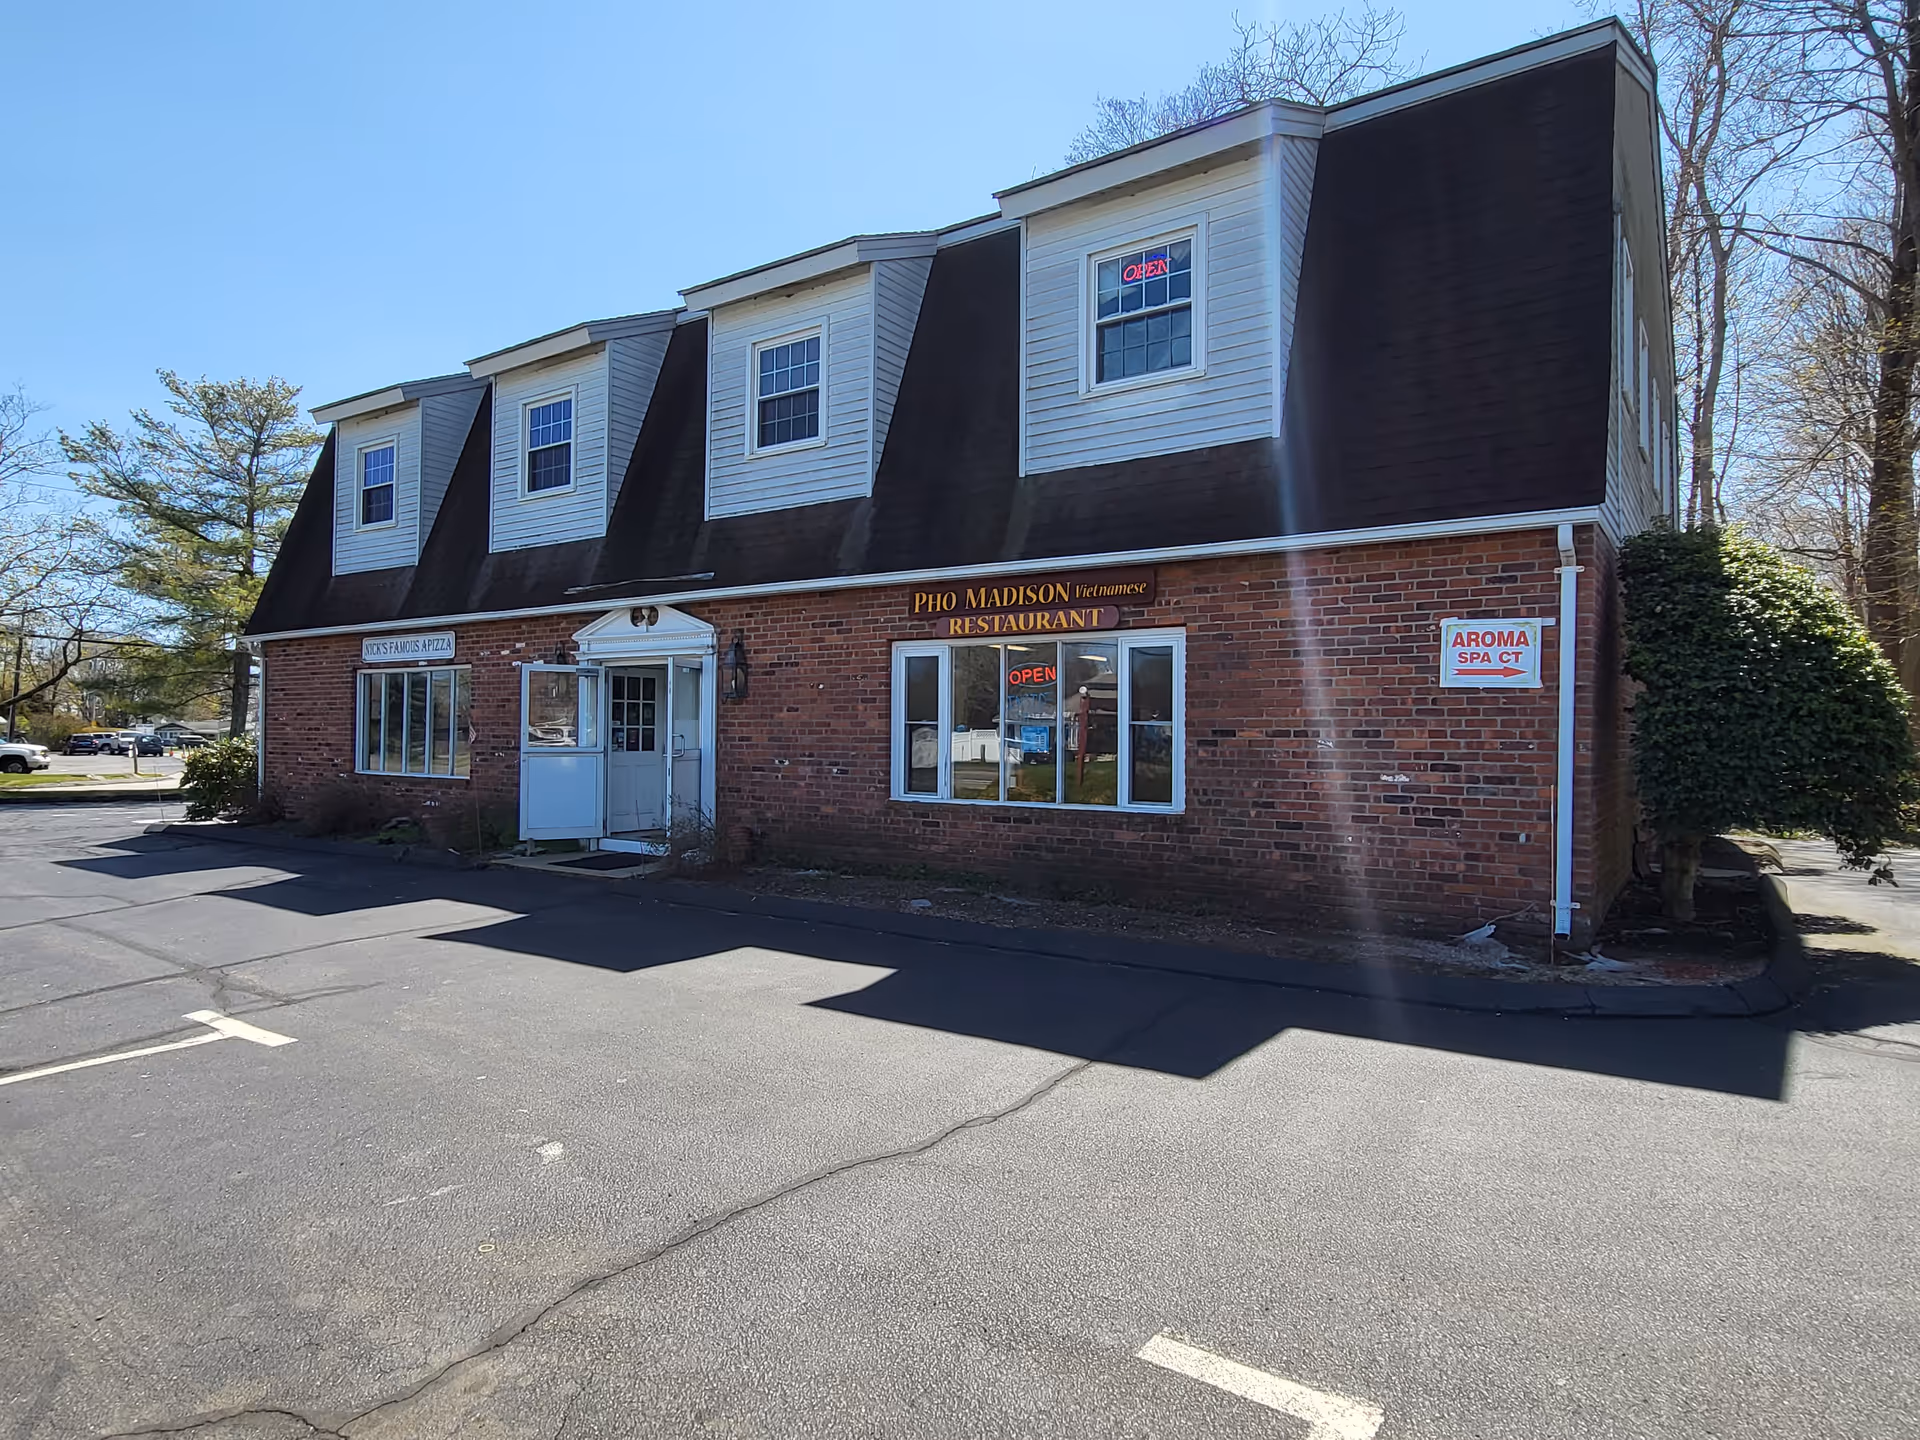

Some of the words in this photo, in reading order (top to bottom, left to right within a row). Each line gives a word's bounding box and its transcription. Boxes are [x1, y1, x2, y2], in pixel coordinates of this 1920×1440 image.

[1123, 257, 1172, 281] OPEN
[914, 591, 956, 613] PHO
[965, 582, 1071, 610] MADISON
[1075, 582, 1147, 599] Vietnamese
[949, 608, 1104, 635] RESTAURANT
[365, 642, 388, 656] NICK'S
[389, 639, 420, 655] FAMOUS
[421, 638, 452, 652] APIZZA
[1452, 631, 1529, 648] AROMA
[1457, 651, 1492, 664] SPA
[1498, 651, 1523, 664] CT
[1009, 666, 1056, 685] OPEN
